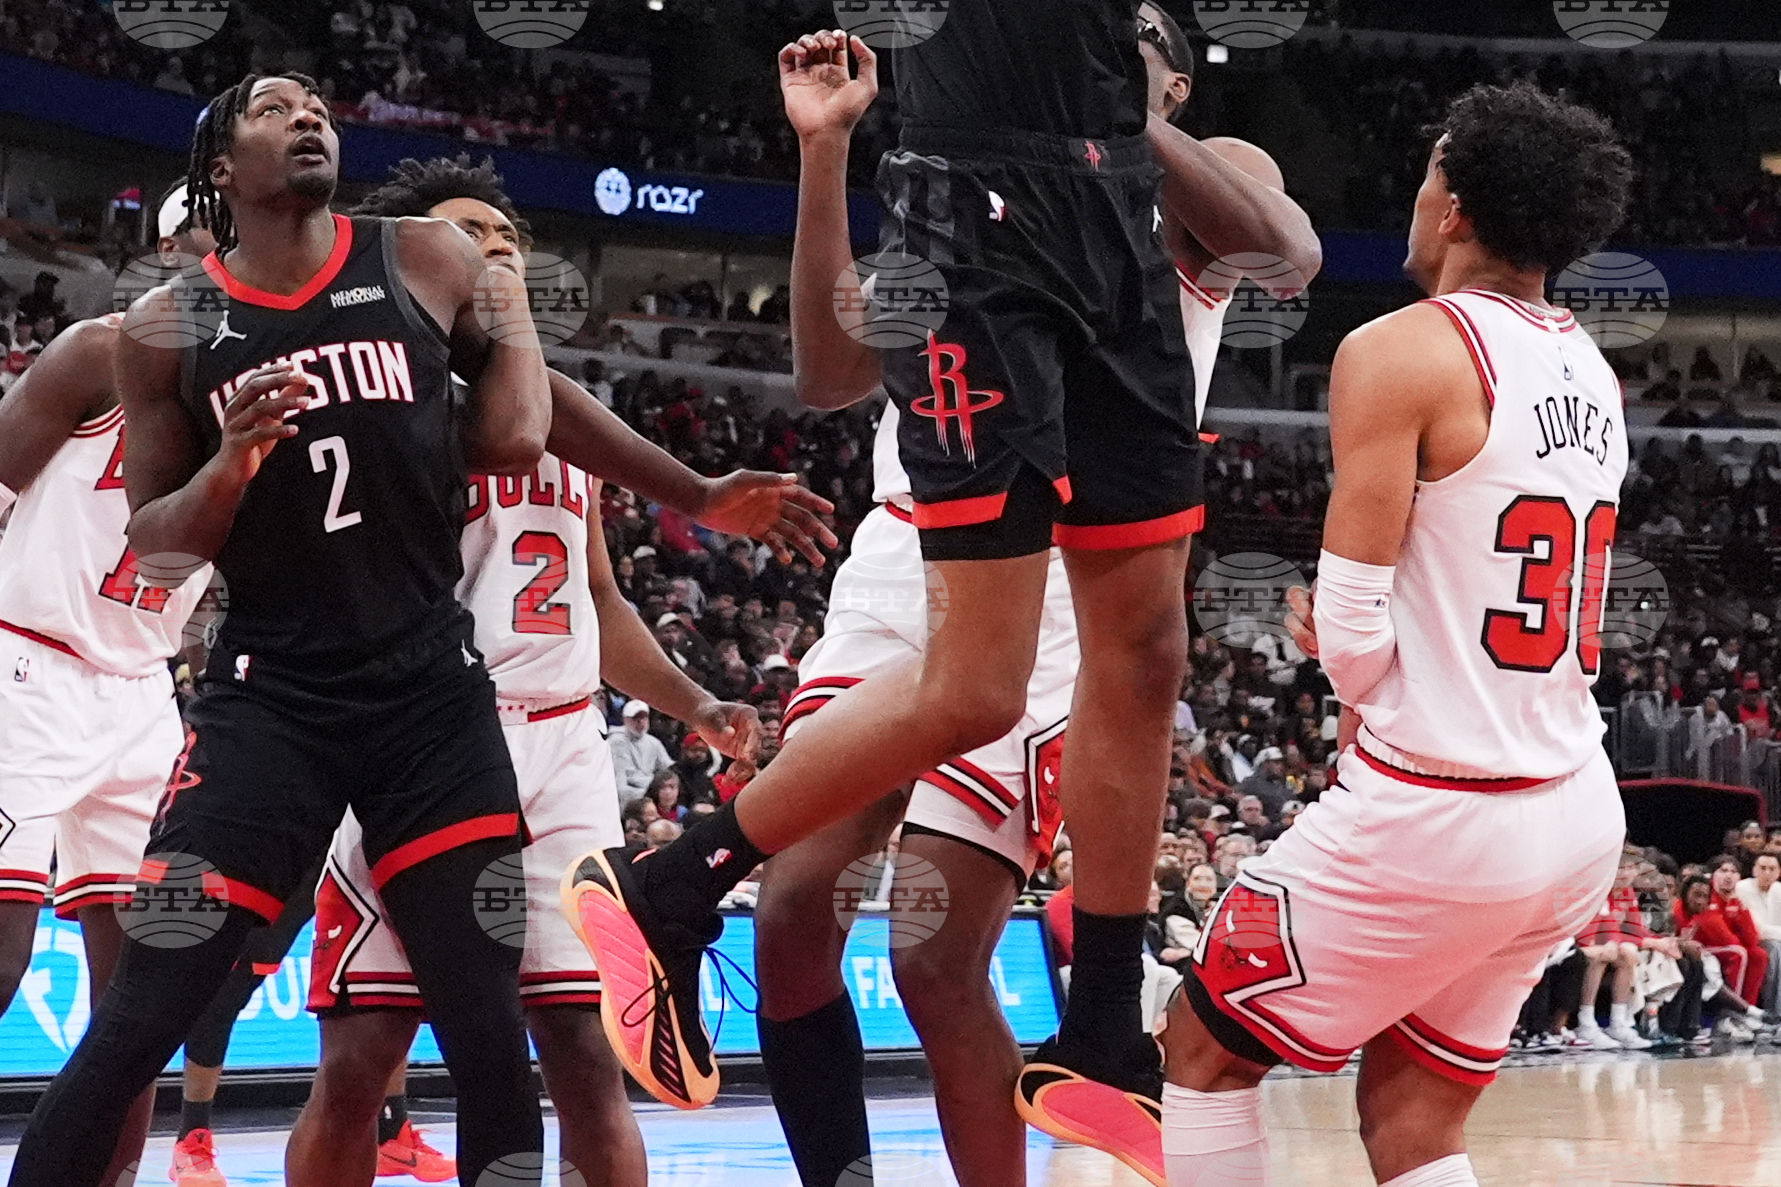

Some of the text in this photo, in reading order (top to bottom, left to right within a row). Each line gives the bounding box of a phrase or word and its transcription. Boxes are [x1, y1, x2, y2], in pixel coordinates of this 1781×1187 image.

[636, 184, 704, 214] razr
[1534, 395, 1613, 466] JONES
[308, 435, 363, 533] 2
[465, 461, 593, 525] BULL
[512, 530, 572, 635] 2
[1480, 494, 1618, 675] 30
